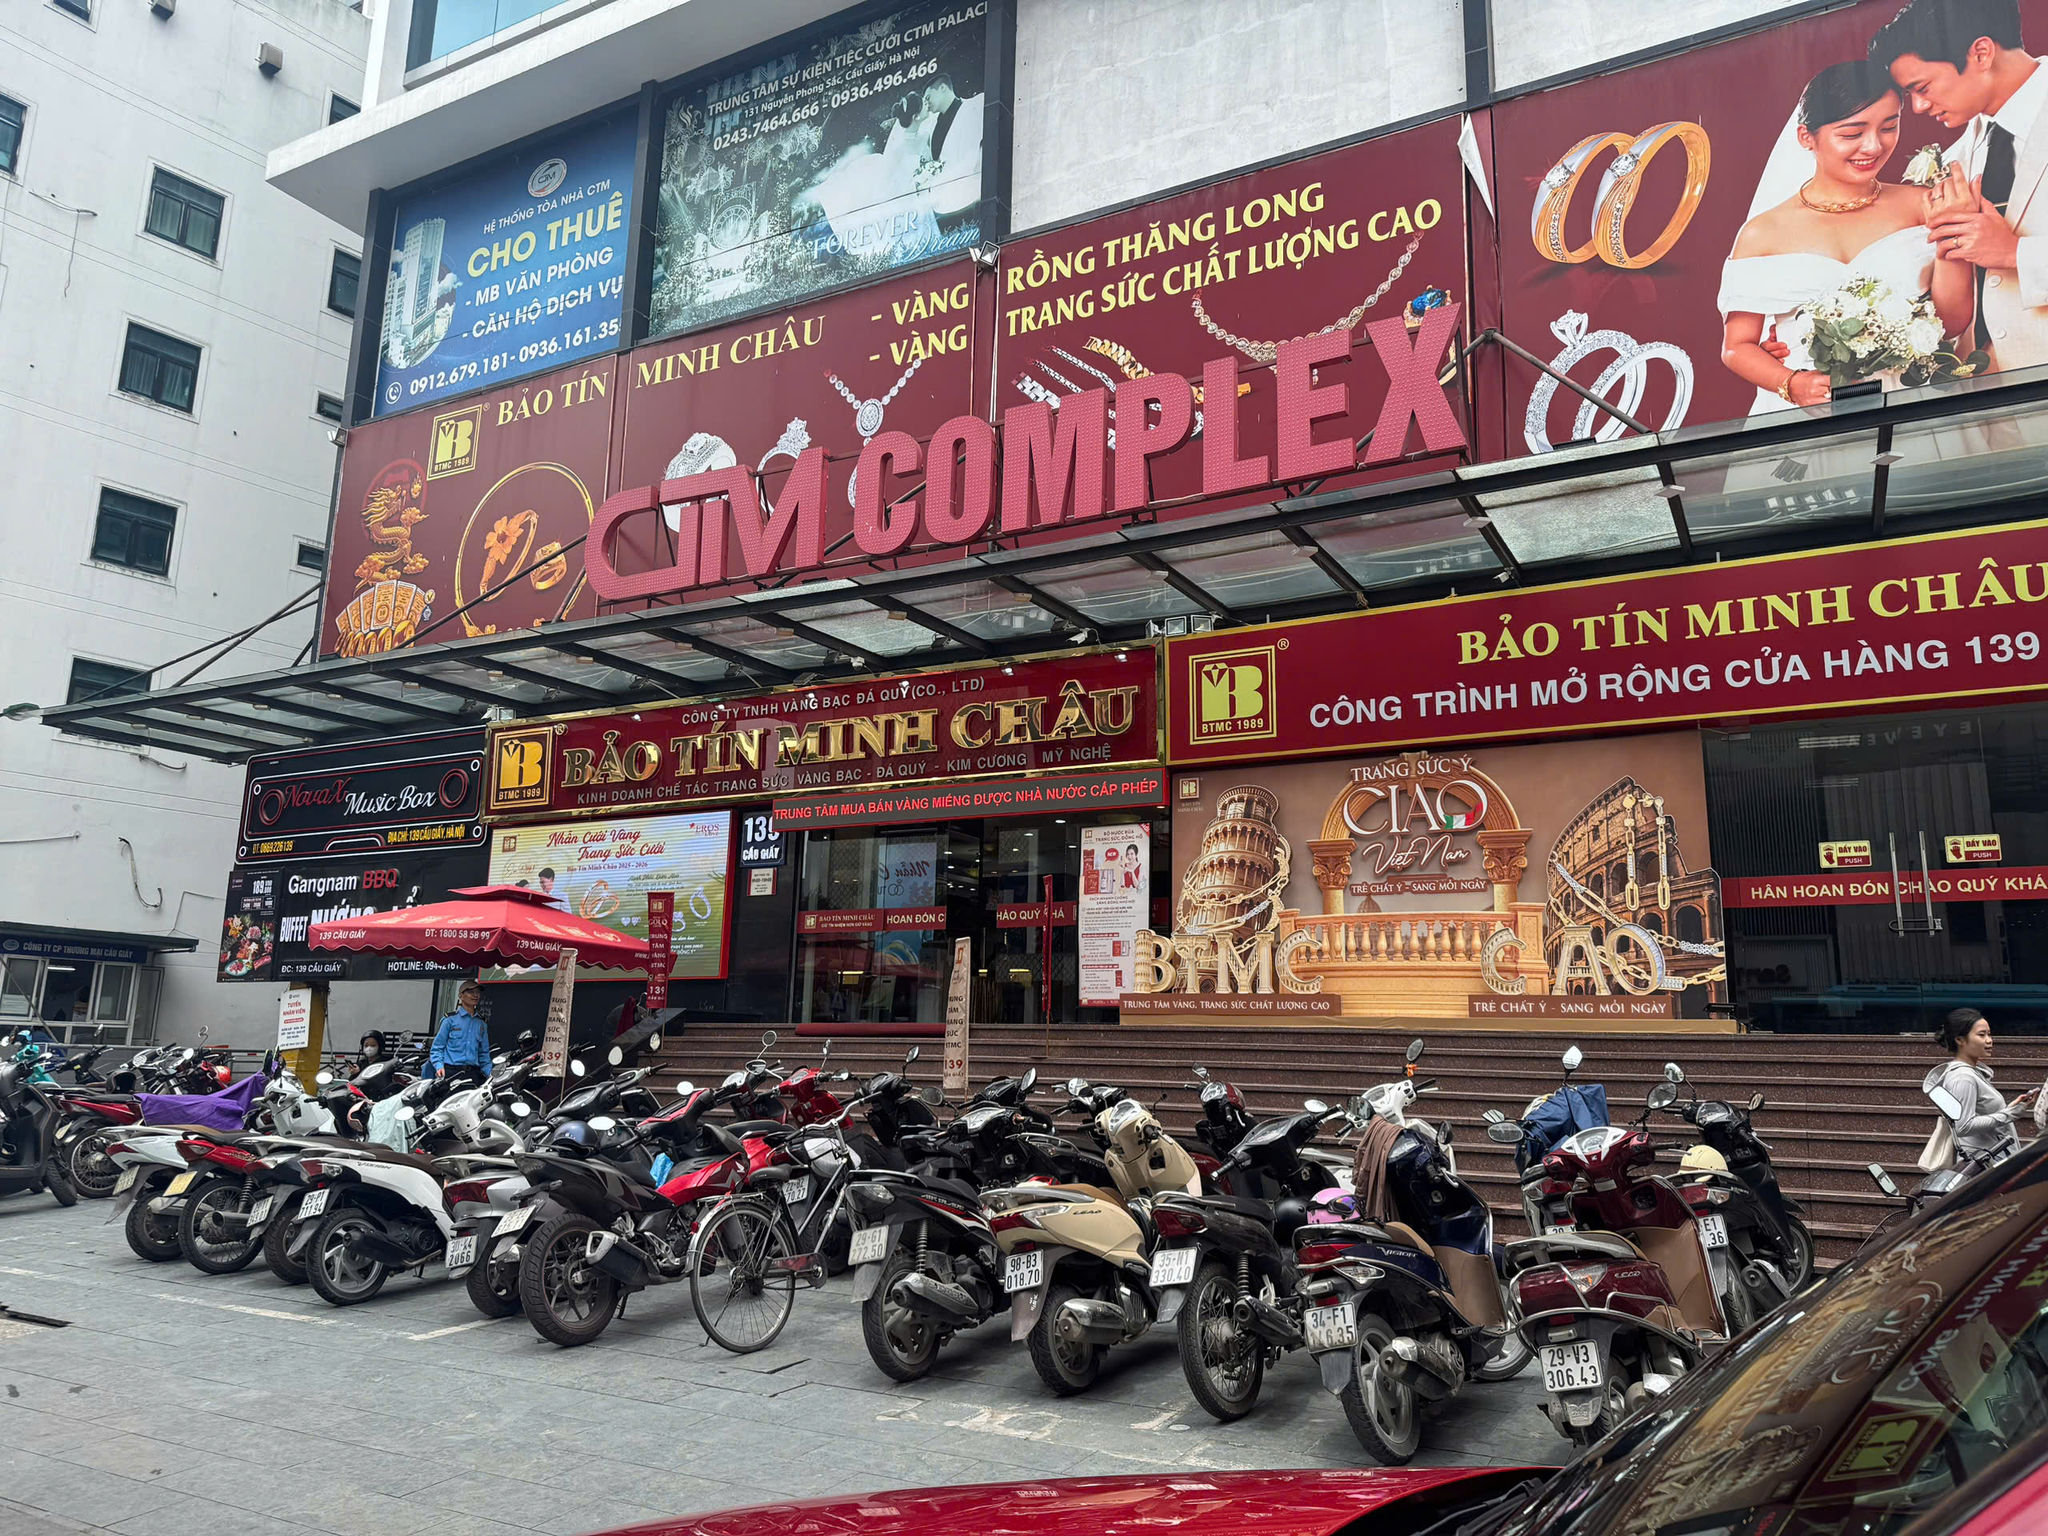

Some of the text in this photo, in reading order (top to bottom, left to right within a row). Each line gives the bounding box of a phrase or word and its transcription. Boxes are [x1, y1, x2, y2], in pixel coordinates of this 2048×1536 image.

[708, 22, 935, 117] TRUNG TÂM SỰ KIỆN TIỆC CƯỚI CTM
[744, 45, 920, 119] 131 Phong Hà Nội
[713, 102, 819, 151] 0243.7464.666
[831, 58, 938, 109] 0936.496.466
[483, 179, 611, 235] HỆ THỐNG TÒA NHÀ CTM
[467, 191, 624, 278] CHO THUÊ
[811, 209, 919, 259] FOREVER
[1006, 182, 1325, 294] RỒNG THĂNG LONG
[475, 246, 613, 308] MB VĂN PHÒNG
[1006, 197, 1443, 337] TRANG SỨC CHẤT LƯỢNG CAO
[472, 275, 624, 339] CĂN HỘ DỊCH VỤ
[891, 282, 970, 326] VÀNG
[635, 315, 826, 389] MINH CHÂU
[889, 323, 968, 367] VÀNG
[496, 370, 608, 427] BẢO TÍN
[584, 302, 1470, 598] CTM COMPLEX
[1457, 557, 2048, 665] BẢO TÍN MINH CHÂU
[1310, 630, 2040, 728] CÔNG TRÌNH MỞ RỘNG CỬA HÀNG 139
[681, 676, 985, 725] CÔNG TY TNHH VÀNG BẠC ĐÁ LTD)
[561, 679, 1139, 788] BẢO TÍN MINH CHÂU
[1202, 718, 1264, 734] BTMC 1989
[577, 741, 1112, 804] KINH DOANH CHẾ TÁC TRANG SỨC VÀNG BẠC ĐÁ QUÝ KIM CƯƠNG MỸ NGHỆ
[1351, 757, 1473, 782] TRANG SỨC Ý
[344, 785, 437, 816] Music Box
[499, 787, 541, 800] BTMC 1989
[774, 778, 1158, 820] TRUNG TÂM MUA BÁN VÀNG MIẾNG ĐƯỢC NHÀ NƯỚC CẤP PHÉP
[1343, 780, 1488, 836] CIAO
[409, 829, 420, 841] 139
[696, 823, 719, 833] EROS
[578, 845, 612, 862] Trang
[1363, 835, 1469, 873] Việt Nam
[1973, 851, 1992, 859] PUSH
[288, 874, 357, 897] Gangnam
[362, 868, 398, 889] BBQ
[1412, 878, 1487, 892] SANG NGÀY
[1751, 874, 2048, 899] HÂN HOAN ĐÓN QUÝ KHÁ
[886, 912, 936, 924] HOAN ĐÓN
[1019, 908, 1040, 920] QUÝ
[279, 915, 308, 943] BUFFET
[319, 931, 331, 939] 139
[425, 929, 490, 939] ĐT: 1800 58 58 99
[23, 941, 62, 953] CÔNG TY CP
[516, 939, 529, 948] 139
[281, 965, 307, 973] ĐC: 139
[387, 961, 424, 971] HOTLINE:
[1133, 929, 1323, 994] BTMC
[1123, 998, 1330, 1012] TRUNG TÂM TRANG SỨC CHẤT LƯỢNG CAO
[1473, 999, 1667, 1014] TRẺ SANG NGÀY
[543, 1051, 561, 1060] 139
[944, 1059, 963, 1070] 139
[1073, 1208, 1102, 1216] LEAD
[855, 1231, 883, 1246] 29-G1
[448, 1250, 471, 1267] 2066
[852, 1245, 883, 1262] 272.50
[1010, 1254, 1038, 1272] 98-B3
[1006, 1269, 1040, 1291] 018.70
[1153, 1266, 1191, 1284] 330.40
[1312, 1308, 1348, 1328] 34-F1
[1548, 1345, 1590, 1368] 29-V3
[1546, 1363, 1599, 1388] 306.43
